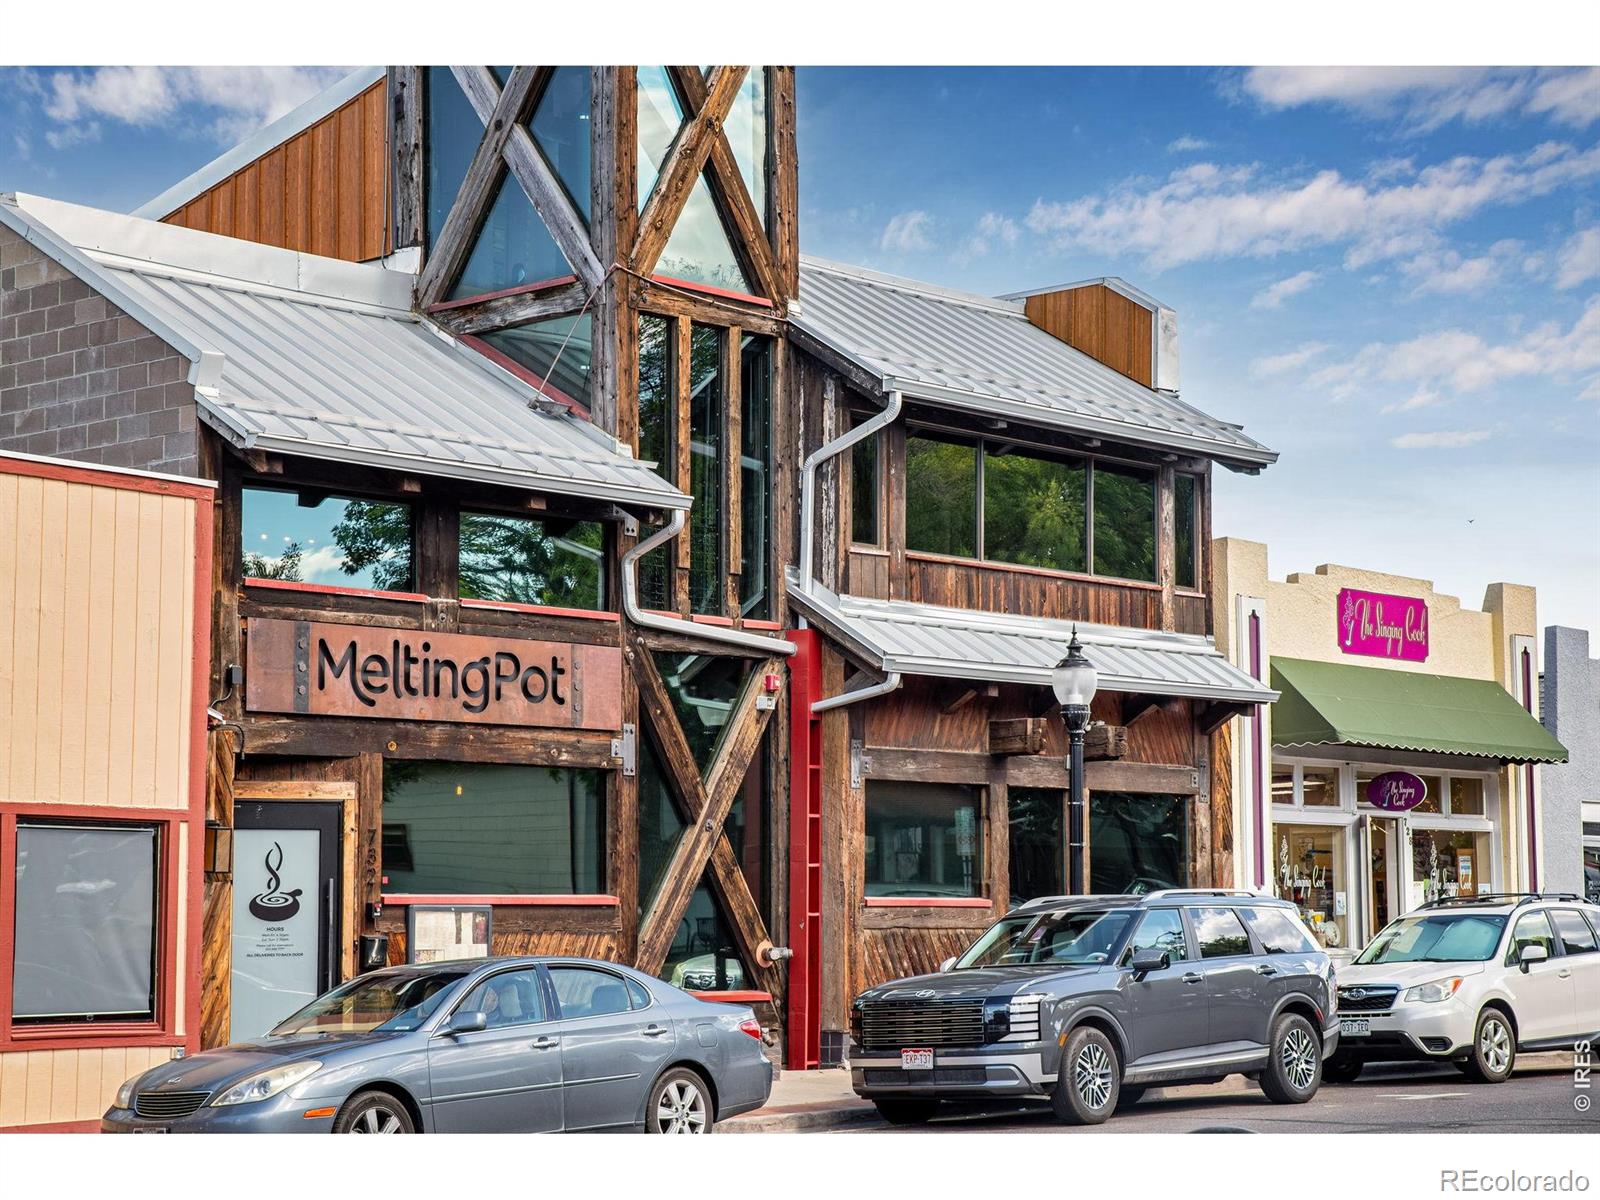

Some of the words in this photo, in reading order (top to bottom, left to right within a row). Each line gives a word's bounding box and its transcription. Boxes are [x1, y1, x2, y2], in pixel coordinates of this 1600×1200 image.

[1354, 598, 1373, 641] The
[1376, 601, 1403, 656] Singing
[1405, 606, 1426, 645] Cook
[317, 637, 566, 714] MeltingPot
[1386, 780, 1398, 795] The
[1398, 780, 1415, 799] Singing
[1393, 794, 1405, 807] Cook
[1280, 863, 1293, 890] The
[1293, 864, 1312, 898] Singing
[1312, 864, 1327, 889] Cook
